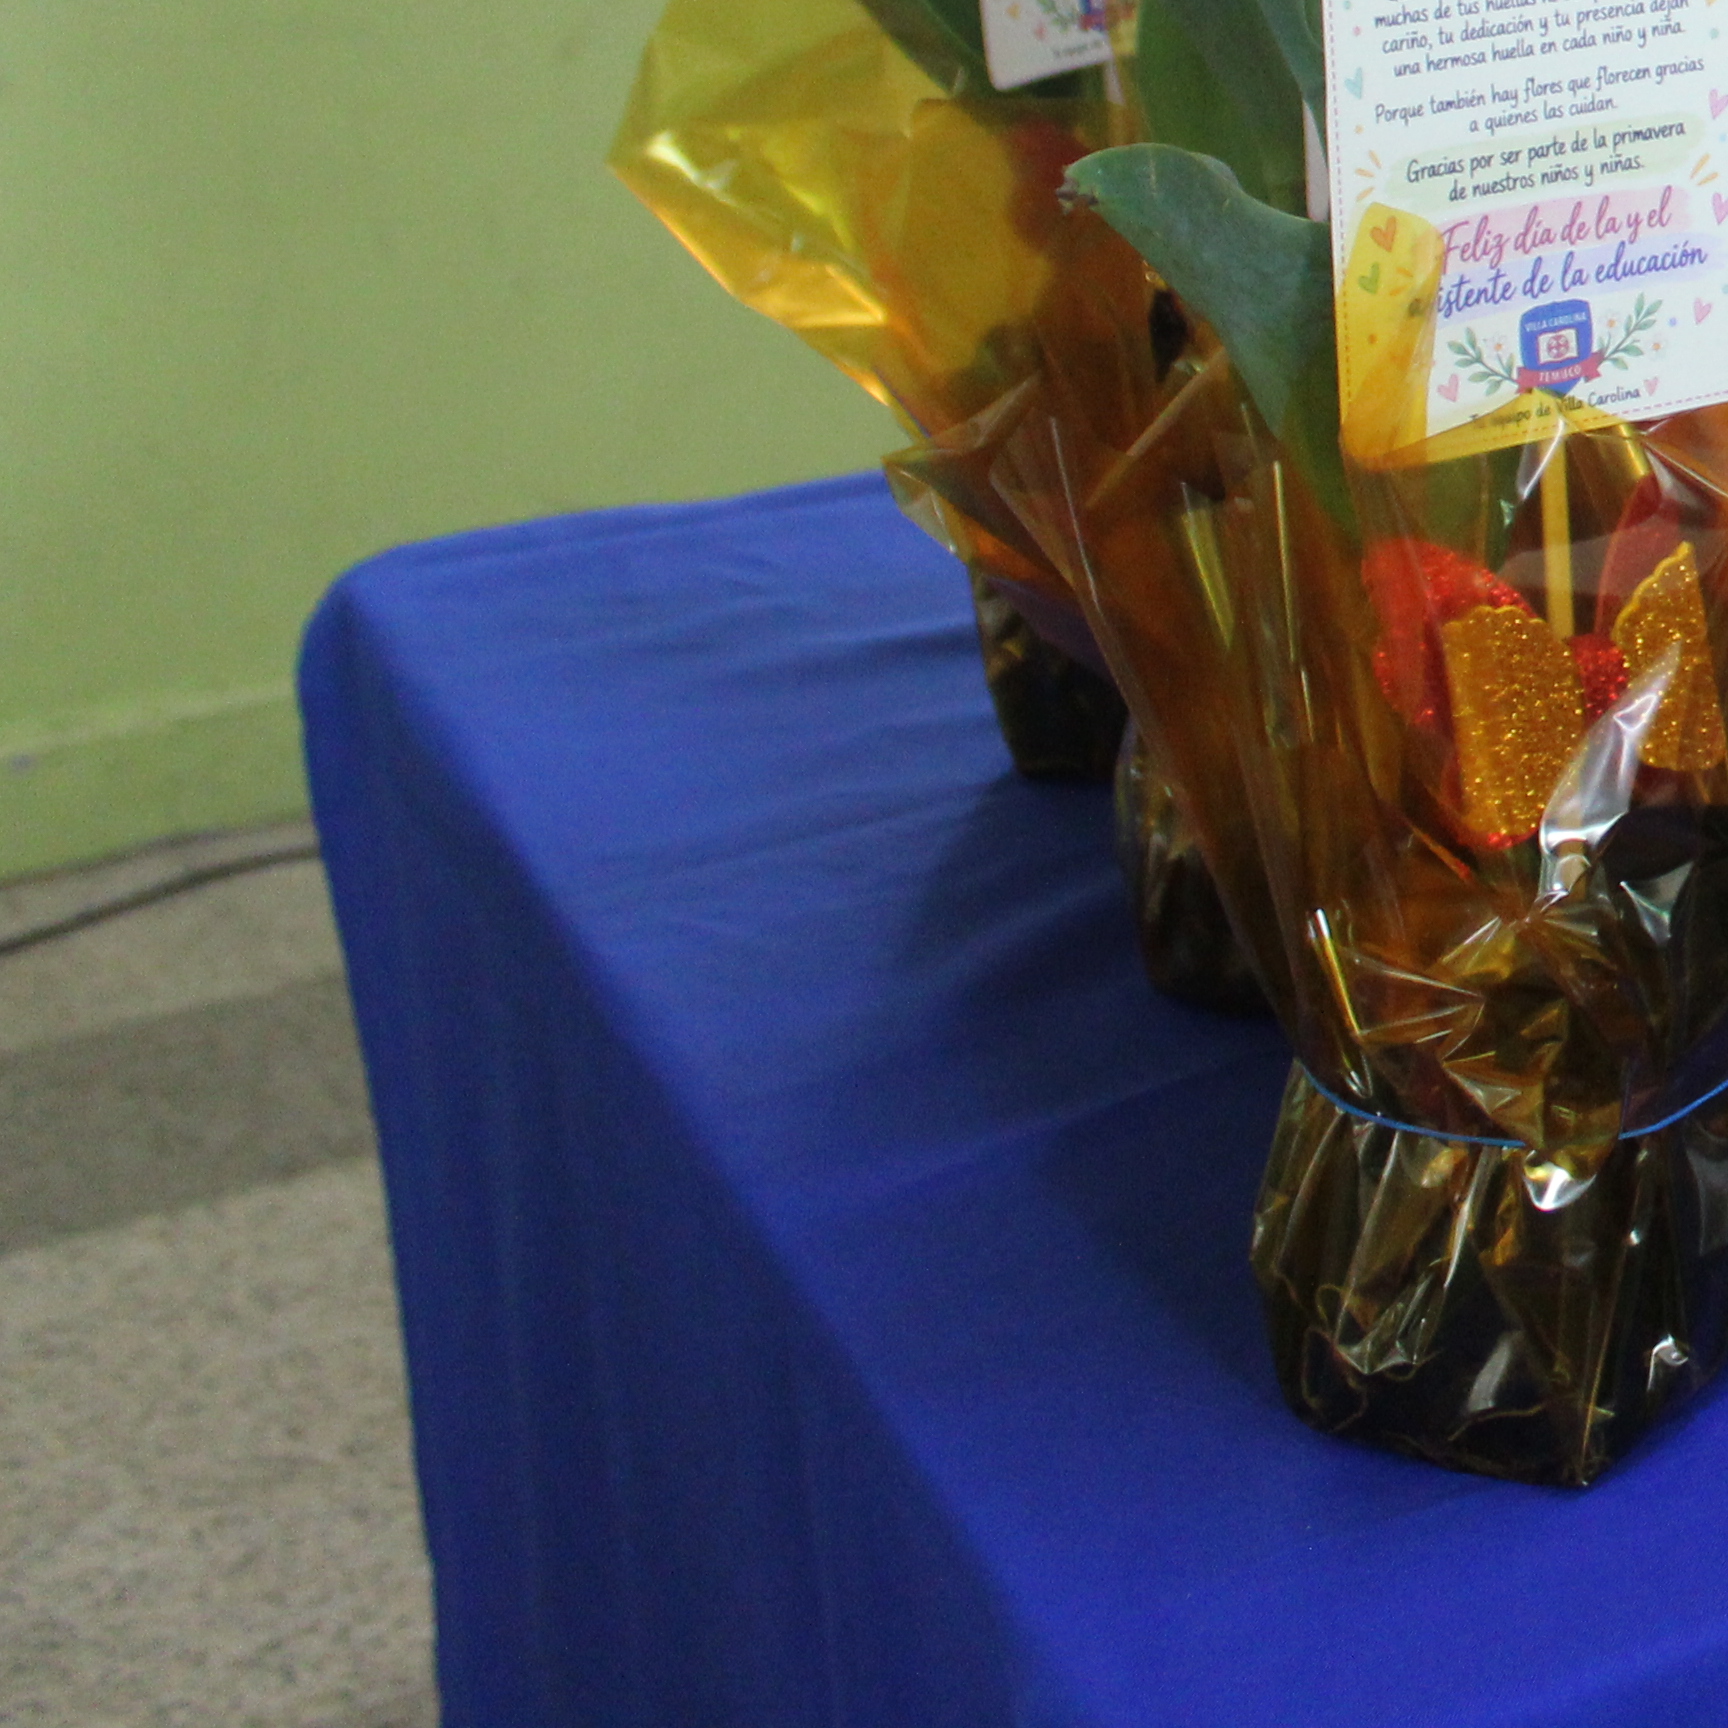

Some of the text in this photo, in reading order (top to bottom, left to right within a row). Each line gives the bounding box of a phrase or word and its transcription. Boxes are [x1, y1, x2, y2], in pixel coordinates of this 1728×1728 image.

[1373, 3, 1429, 28] muchas
[1381, 30, 1433, 54] cariño,
[1437, 26, 1454, 45] tu
[1459, 13, 1534, 42] dedicación
[1538, 16, 1549, 37] y
[1553, 8, 1571, 27] tu
[1393, 61, 1421, 77] una
[1424, 50, 1487, 72] hermosa
[1490, 37, 1535, 62] huella
[1539, 40, 1558, 55] en
[1561, 28, 1597, 52] cada
[1601, 24, 1633, 44] niño
[1636, 26, 1647, 49] y
[1374, 57, 1705, 126] Porque también hay flores que florecen gracias
[1468, 119, 1479, 133] a
[1484, 108, 1538, 136] quienes
[1542, 99, 1564, 120] las
[1405, 121, 1686, 184] Gracias por ser parte de la primavera
[1447, 152, 1644, 202] de nuestros niños y niñas.
[1440, 184, 1672, 275] Feliz día de la y el
[1521, 256, 1554, 298] de
[1559, 249, 1588, 293] la
[1594, 237, 1708, 284] educación
[1524, 321, 1548, 333] VILLA
[1538, 364, 1582, 383] TEMUCO
[1588, 385, 1642, 408] Carolina
